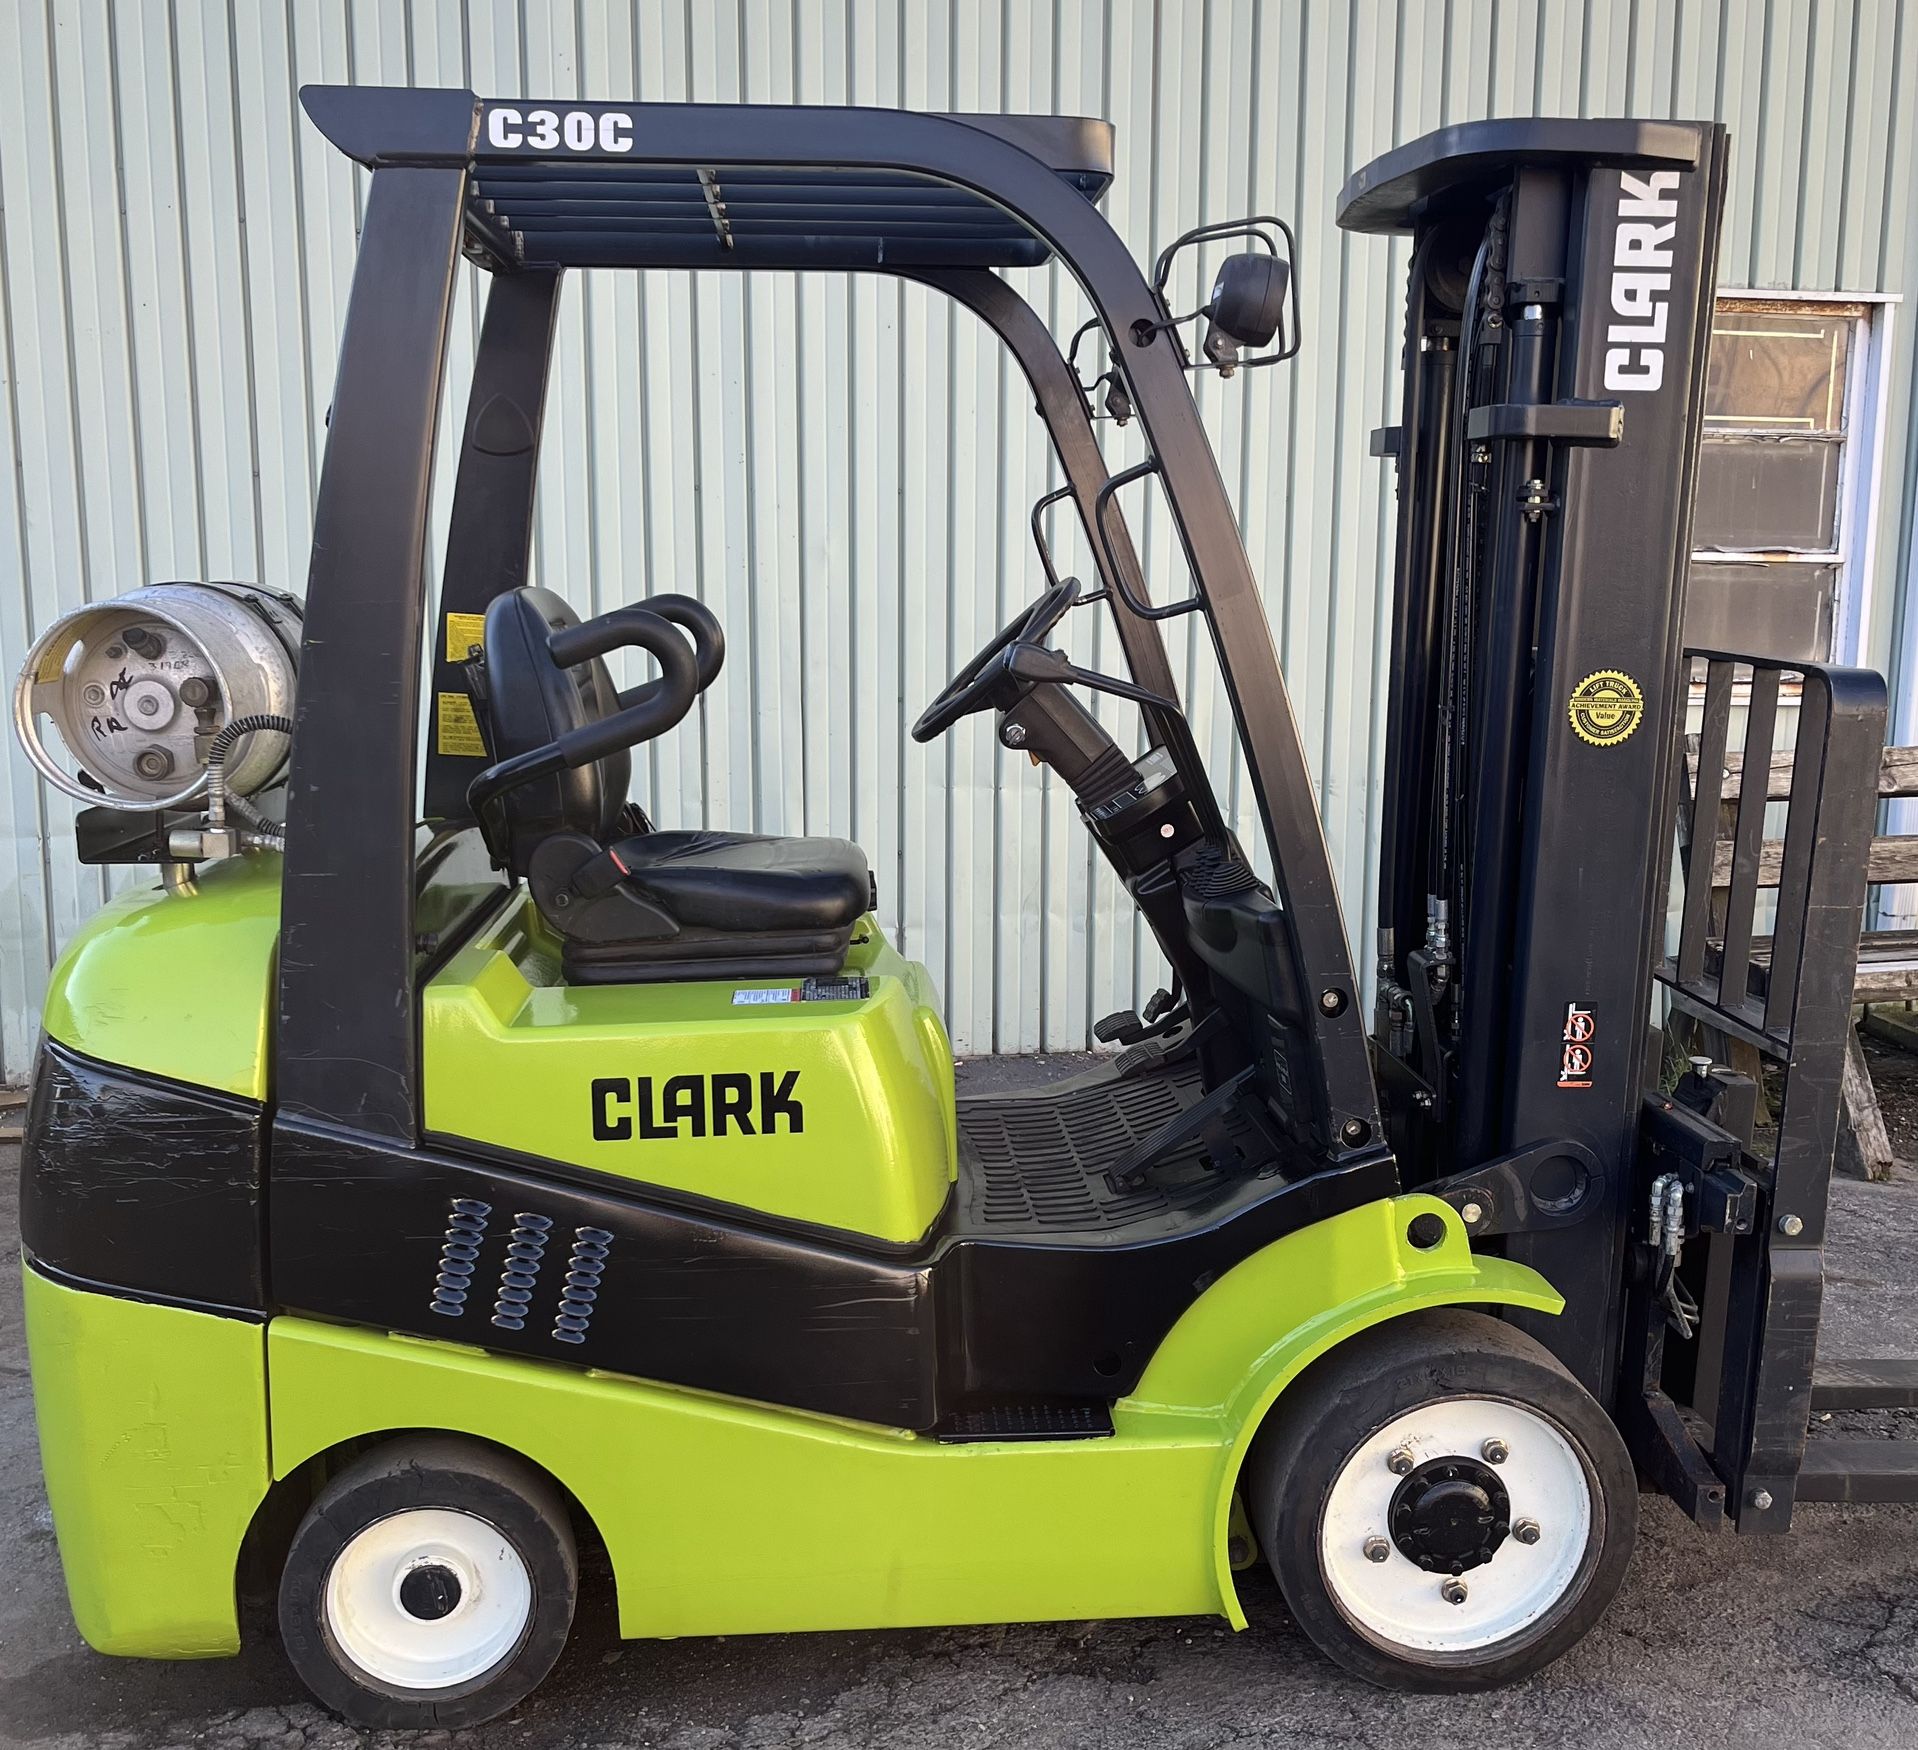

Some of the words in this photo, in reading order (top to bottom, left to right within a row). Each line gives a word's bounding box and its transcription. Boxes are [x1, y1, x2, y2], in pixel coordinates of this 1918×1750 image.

[488, 108, 634, 153] C30C
[1603, 170, 1681, 392] CLARK
[1589, 682, 1604, 693] LIFT
[1605, 681, 1628, 695] TRUCK
[1580, 712, 1600, 735] CUSTOMER
[1600, 713, 1631, 736] SATISFACTION
[1595, 711, 1616, 720] Value
[591, 1070, 803, 1142] CLARK
